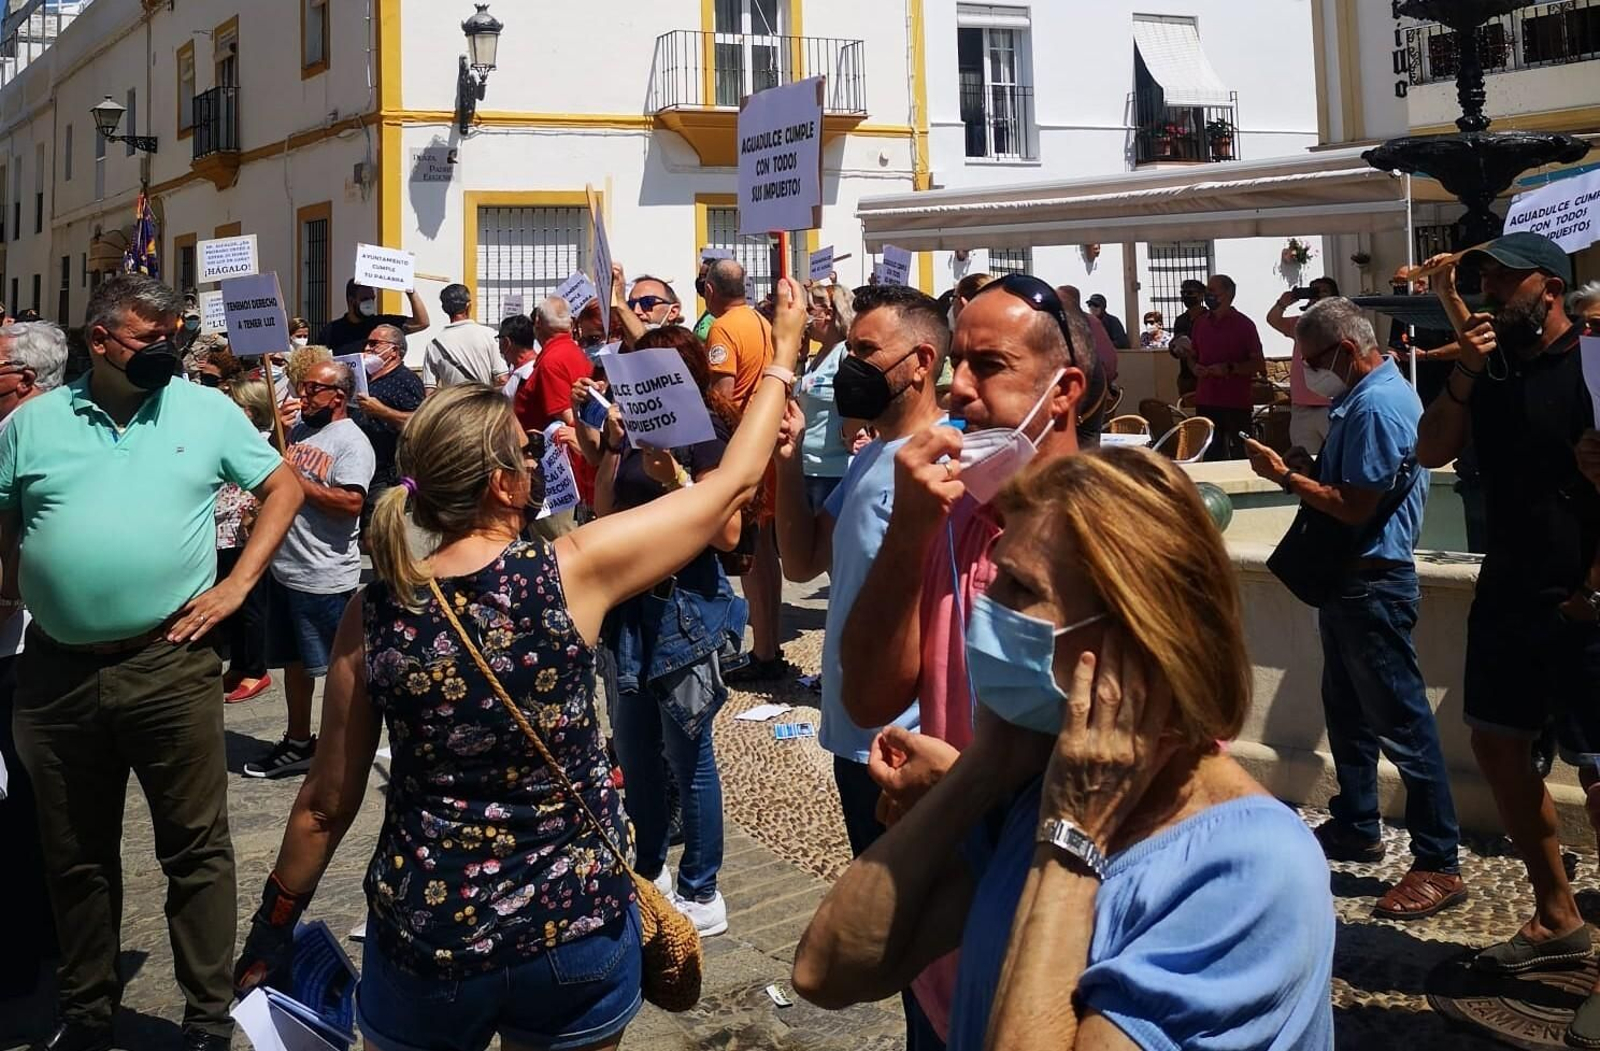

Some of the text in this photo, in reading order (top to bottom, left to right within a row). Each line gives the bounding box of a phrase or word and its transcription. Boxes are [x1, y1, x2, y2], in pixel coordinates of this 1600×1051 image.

[741, 121, 815, 155] AGUADULCE CUMPLE
[756, 151, 798, 176] CON TODOS
[751, 178, 801, 203] SUS IMPUESTOS
[1509, 200, 1570, 227] AGUADULCE
[1530, 207, 1588, 233] CON TODOS
[226, 301, 251, 312] TENEMOS
[251, 297, 278, 309] DERECHO
[238, 316, 276, 330] A TENER LUZ
[635, 373, 684, 396] CUMPLE
[627, 397, 663, 415] TODOS
[625, 411, 677, 433] MPUESTOS
